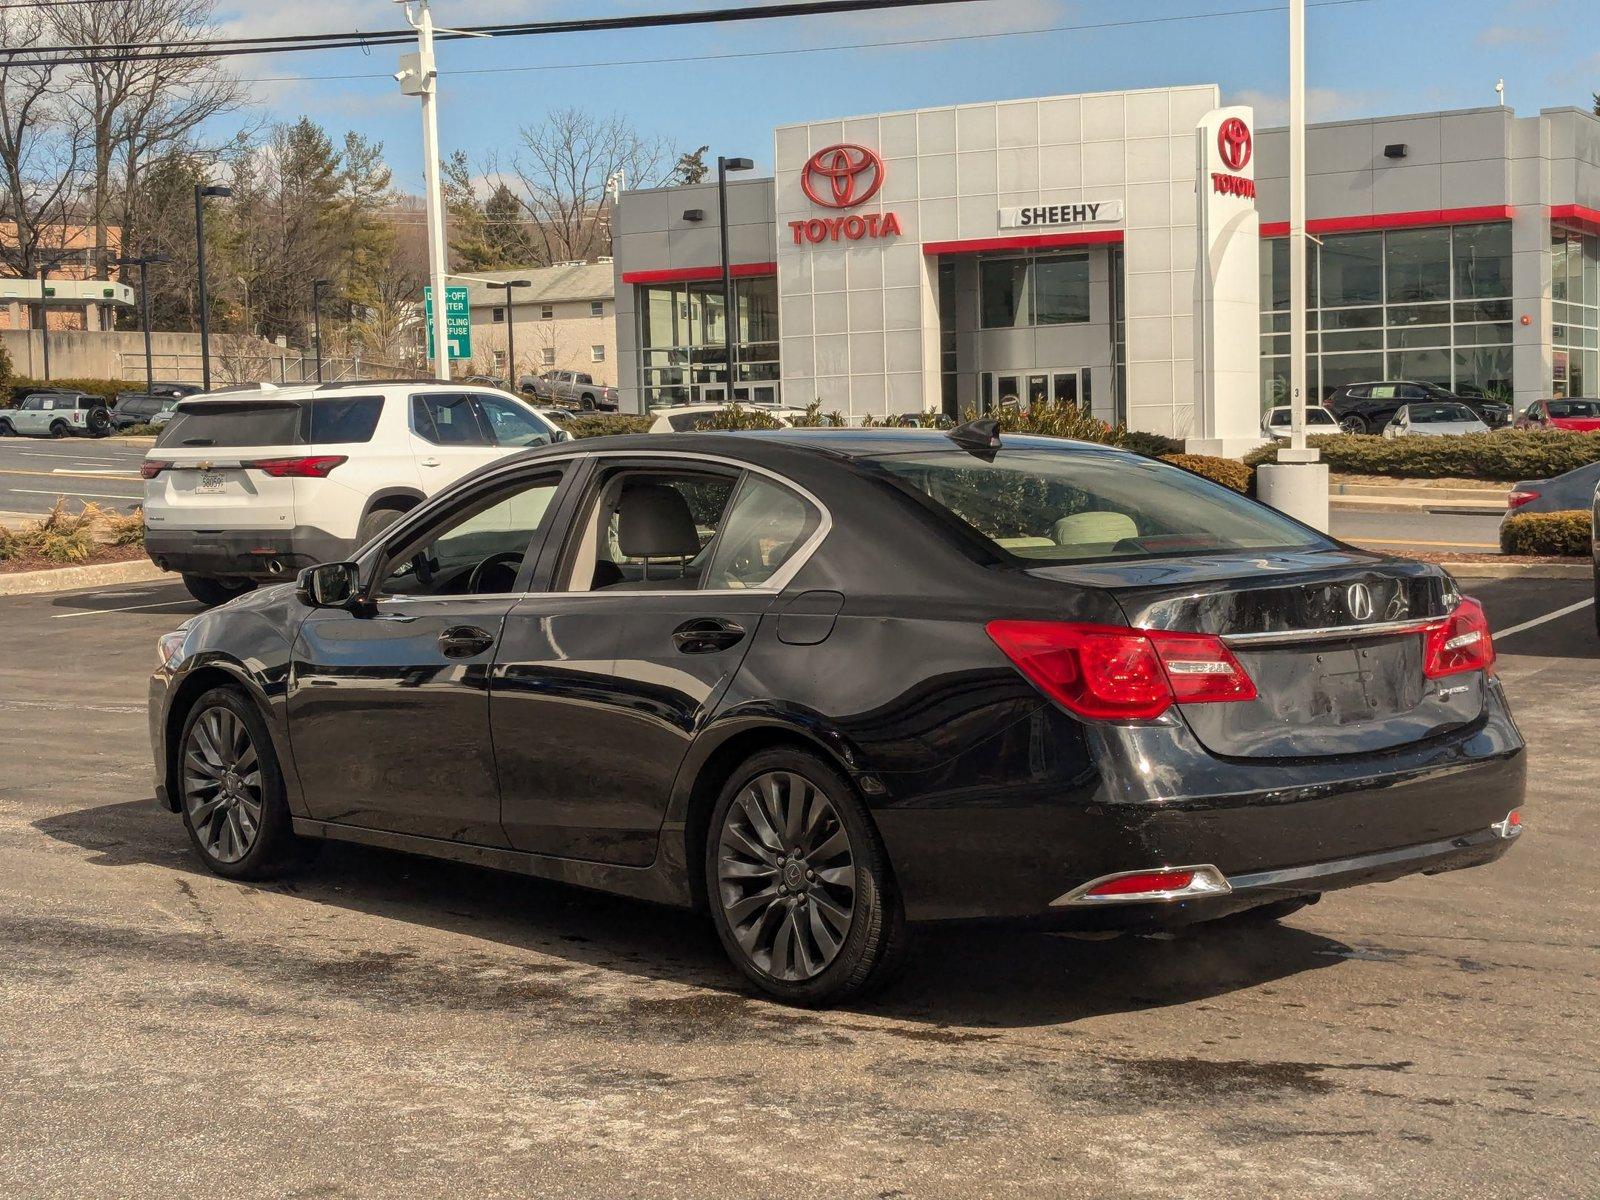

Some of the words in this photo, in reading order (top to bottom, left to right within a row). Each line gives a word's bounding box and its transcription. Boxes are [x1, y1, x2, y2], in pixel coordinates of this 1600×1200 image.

[1211, 173, 1257, 199] TOYOTA
[1020, 203, 1101, 226] SHEEHY
[787, 212, 902, 245] TOYOTA
[1294, 388, 1299, 398] 3
